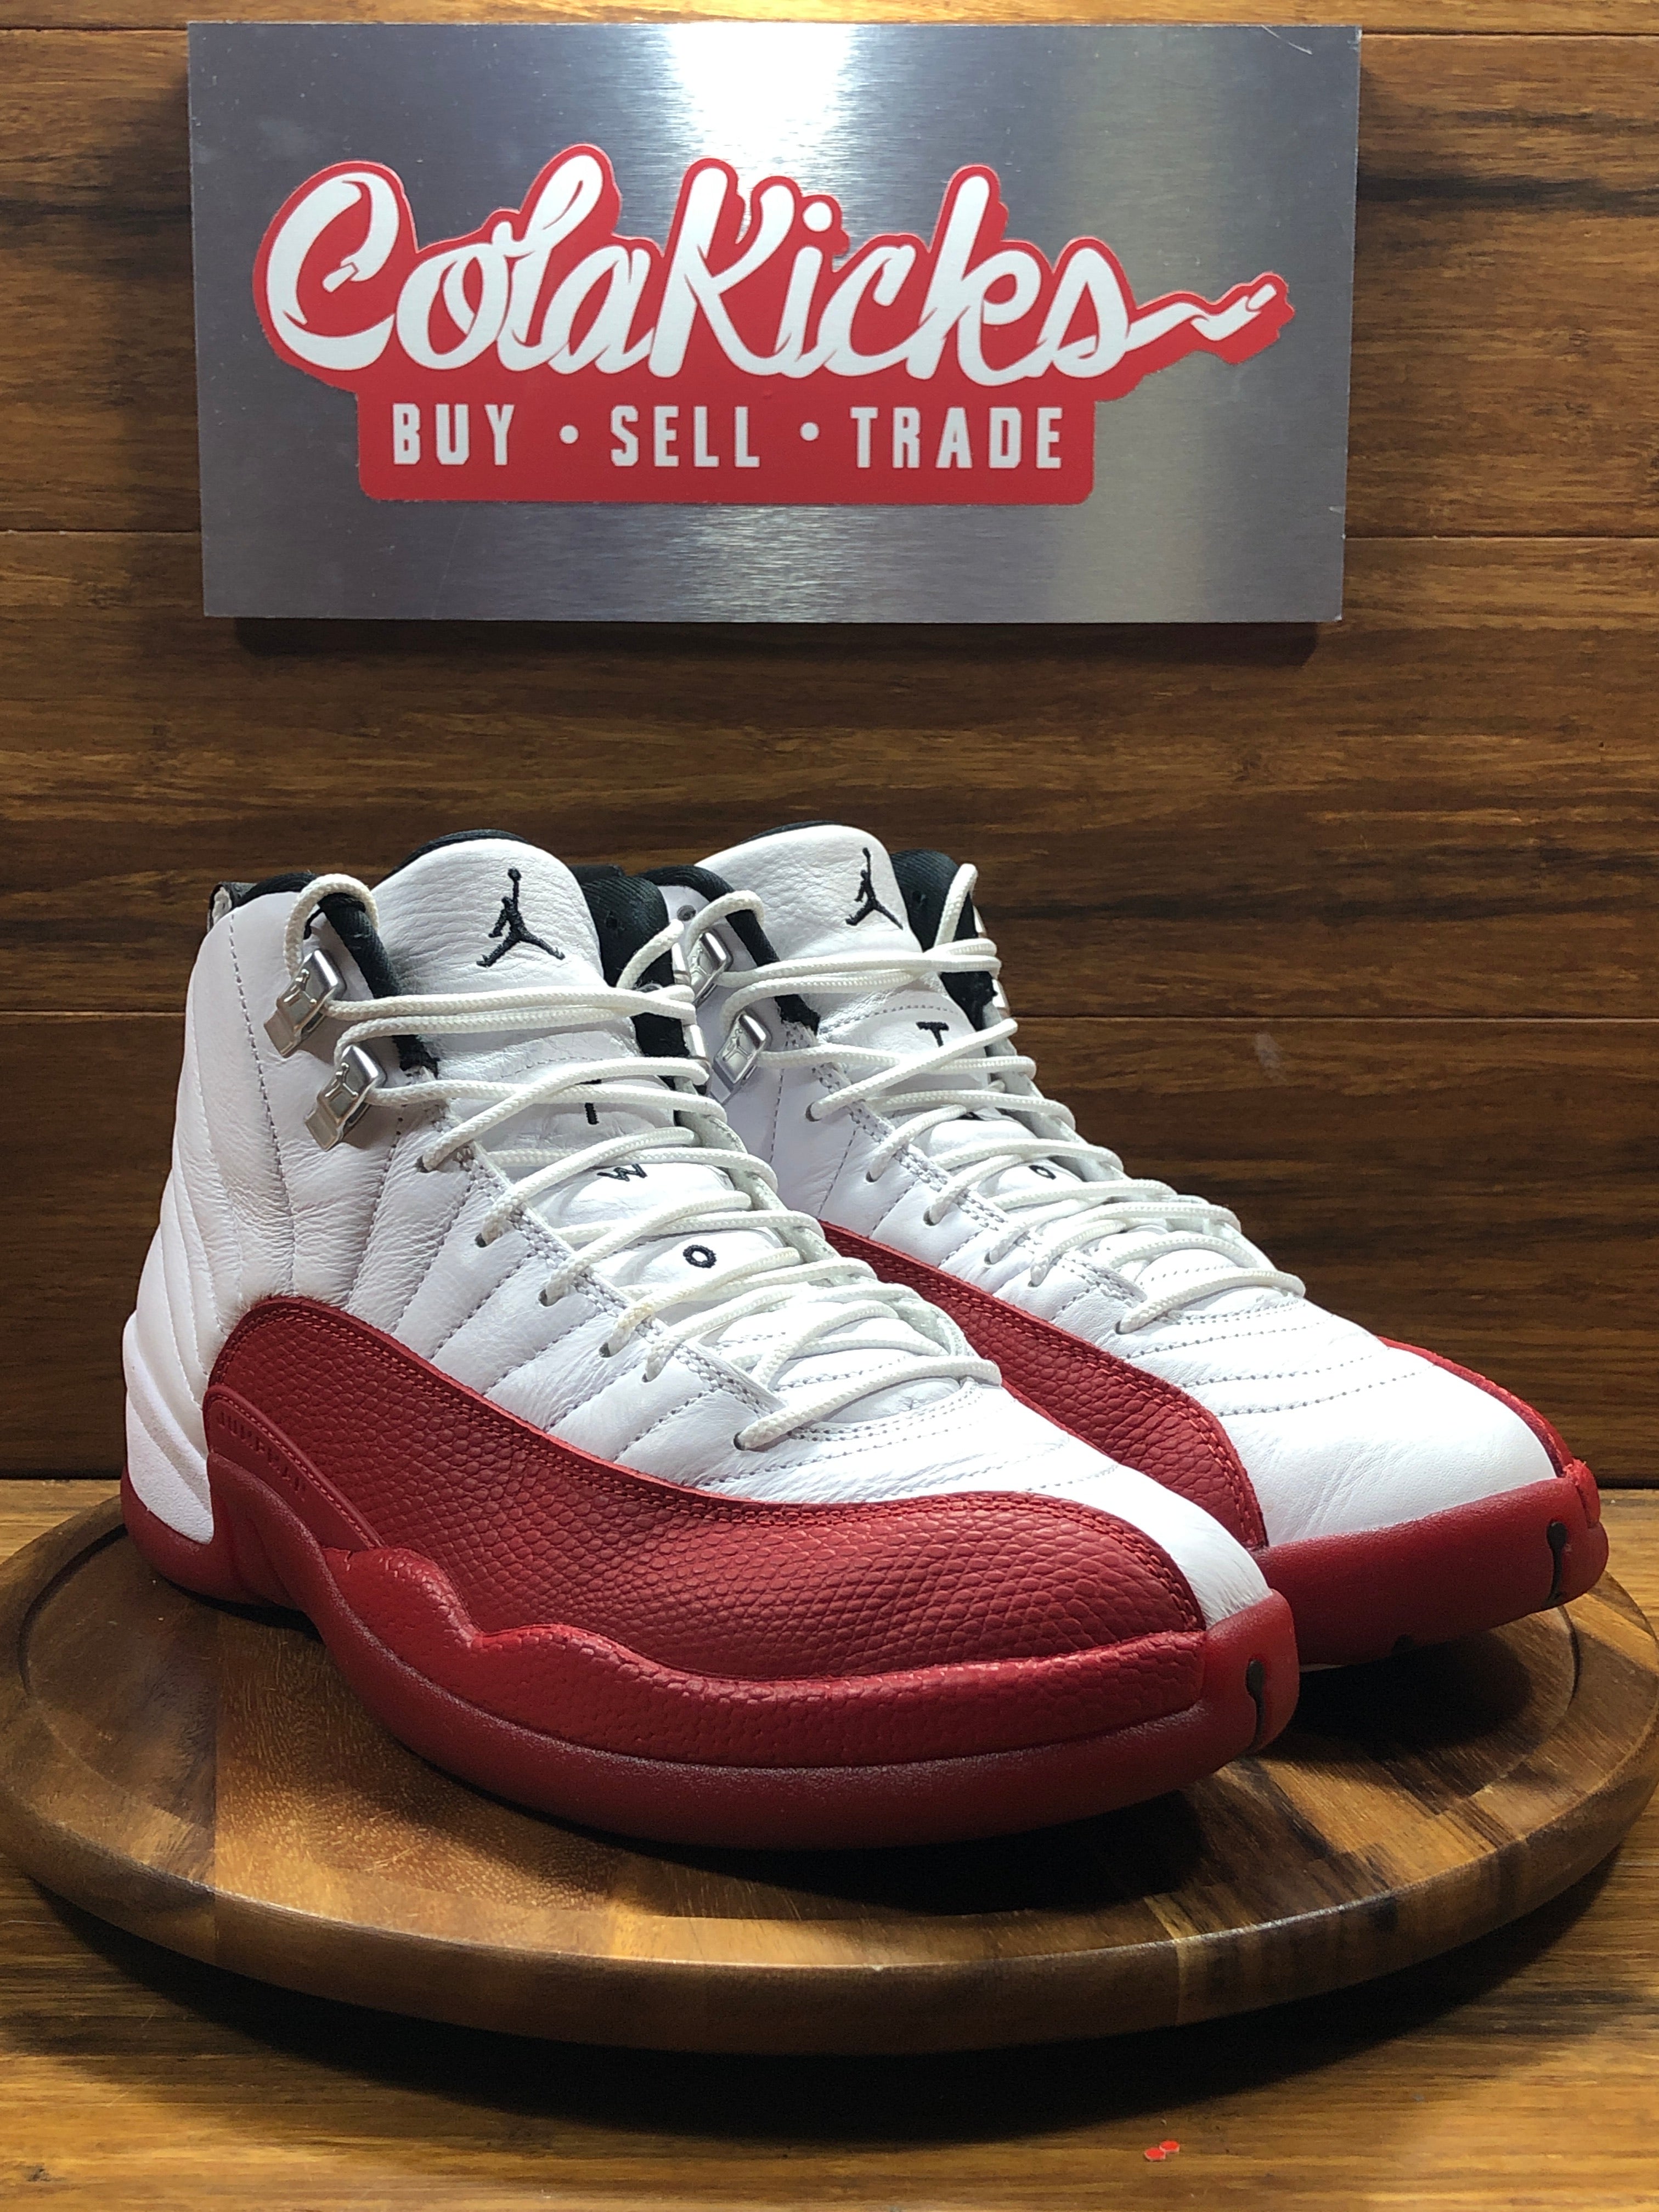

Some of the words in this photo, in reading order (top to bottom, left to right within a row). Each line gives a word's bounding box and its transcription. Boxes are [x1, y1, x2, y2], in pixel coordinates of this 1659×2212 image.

[393, 403, 515, 465] BUY
[611, 405, 760, 467] SELL
[850, 407, 1063, 469] TRADE
